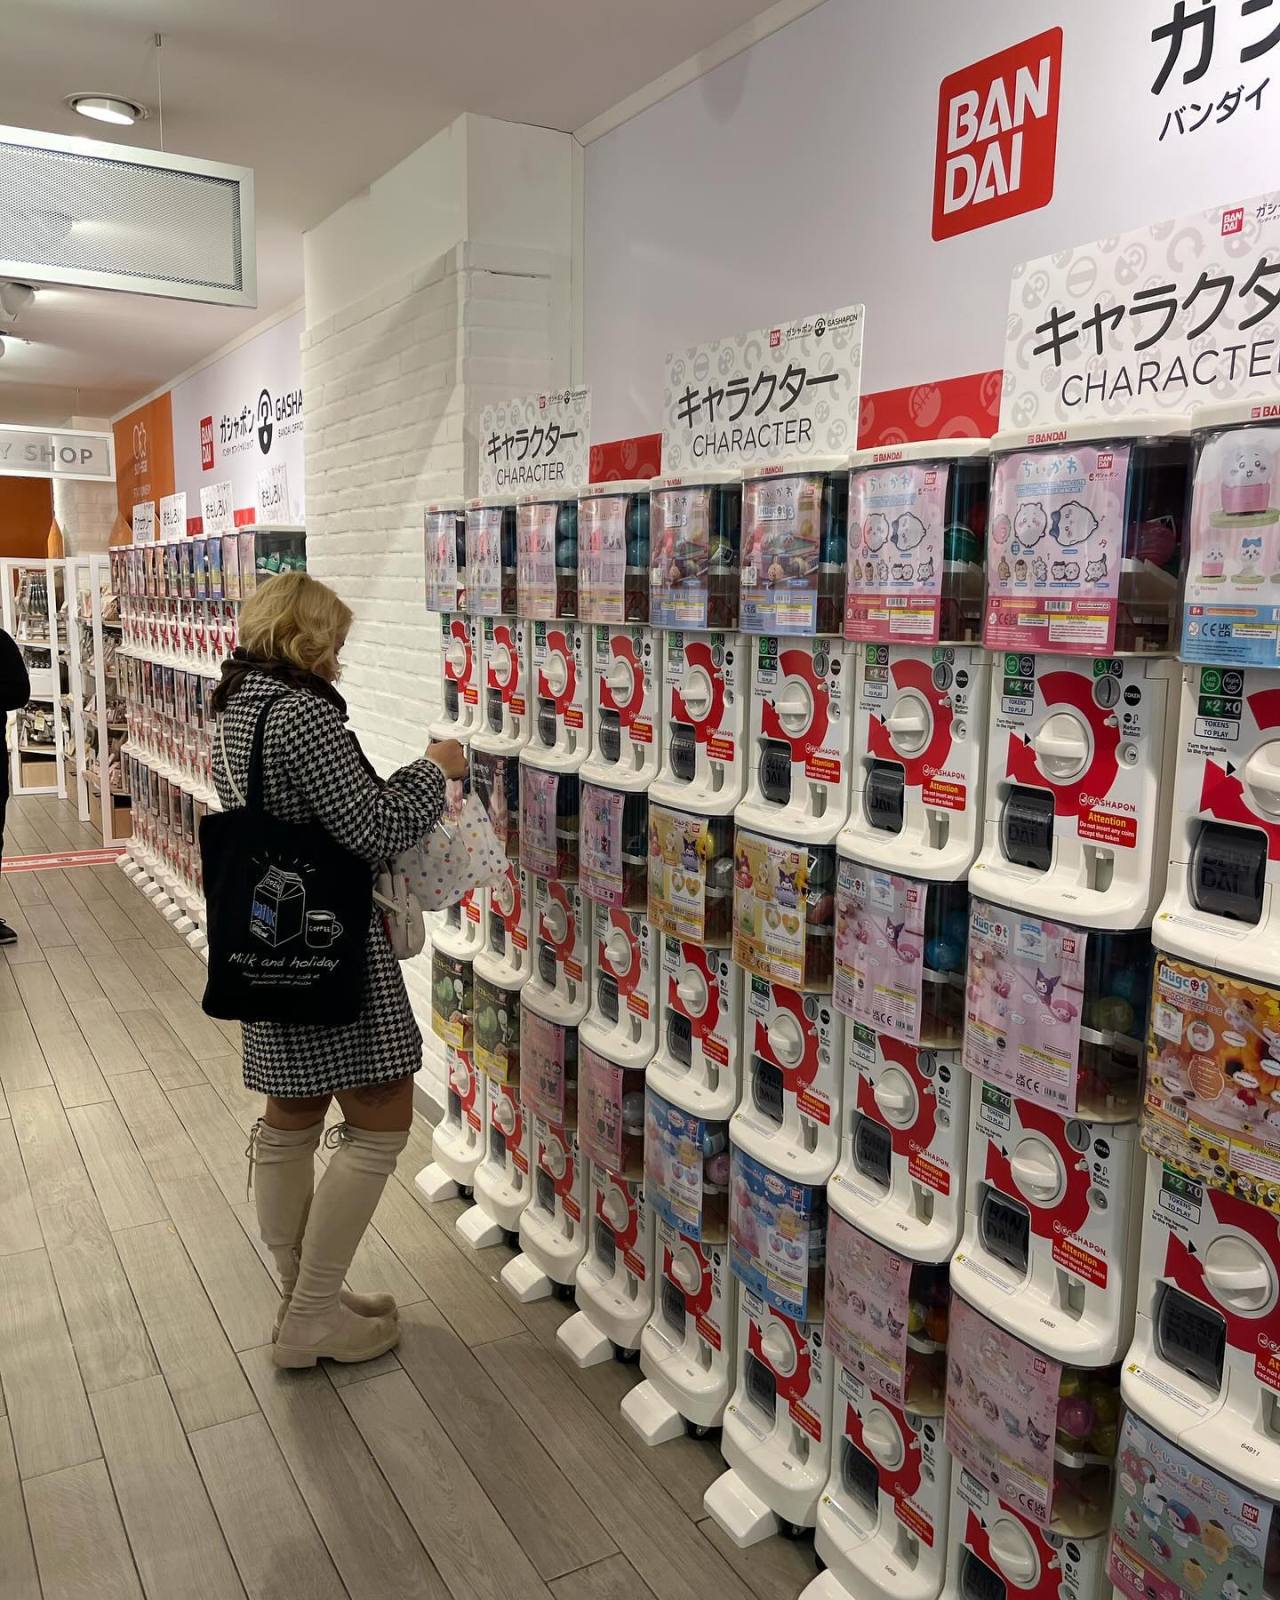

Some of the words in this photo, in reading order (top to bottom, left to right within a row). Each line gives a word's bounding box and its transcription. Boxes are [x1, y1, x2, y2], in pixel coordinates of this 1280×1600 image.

[947, 56, 1051, 154] BAN
[1159, 78, 1271, 141] バンダイ
[943, 131, 1023, 215] DAI
[1224, 211, 1242, 223] BAN
[1255, 202, 1280, 218] ガシ
[1223, 221, 1237, 232] DAI
[827, 313, 858, 327] GASHAPON
[677, 363, 839, 429] キャラクター
[275, 388, 303, 422] GASHA
[220, 404, 255, 444] ガシャポン
[487, 422, 578, 464] キャラクター
[692, 417, 812, 457] CHARACTER
[1035, 431, 1067, 444] BANDAI
[24, 444, 93, 464] SHOP
[879, 451, 903, 462] BANDAI
[496, 462, 565, 486] CHARACTER
[1022, 456, 1078, 478] ちいかわ
[867, 475, 912, 492] ちいかわ
[1202, 623, 1217, 637] CE
[1218, 630, 1231, 638] CA
[1204, 720, 1230, 729] TOKENS
[1213, 730, 1229, 738] PLAY
[930, 780, 959, 794] Attention
[1087, 796, 1136, 813] GASHAPON
[1087, 812, 1127, 828] Attention
[1079, 820, 1086, 828] Do
[1096, 824, 1111, 833] insert
[1111, 828, 1120, 836] any
[1121, 830, 1135, 838] coins
[1079, 829, 1096, 838] except
[1096, 831, 1105, 839] the
[1105, 834, 1120, 842] token
[308, 925, 331, 933] COFFEE
[228, 952, 258, 967] Milk
[260, 956, 286, 967] and
[289, 955, 340, 972] holiday
[1016, 1072, 1026, 1080] UK
[1026, 1078, 1040, 1094] CE
[1168, 1203, 1176, 1211] TO
[1176, 1206, 1192, 1218] PLAY
[1169, 1194, 1192, 1211] TOKENS
[1060, 1225, 1107, 1257] GASHAPON
[1061, 1240, 1098, 1268] Attention
[1257, 1361, 1265, 1371] Do
[1266, 1367, 1277, 1378] not
[1256, 1370, 1277, 1388] except
